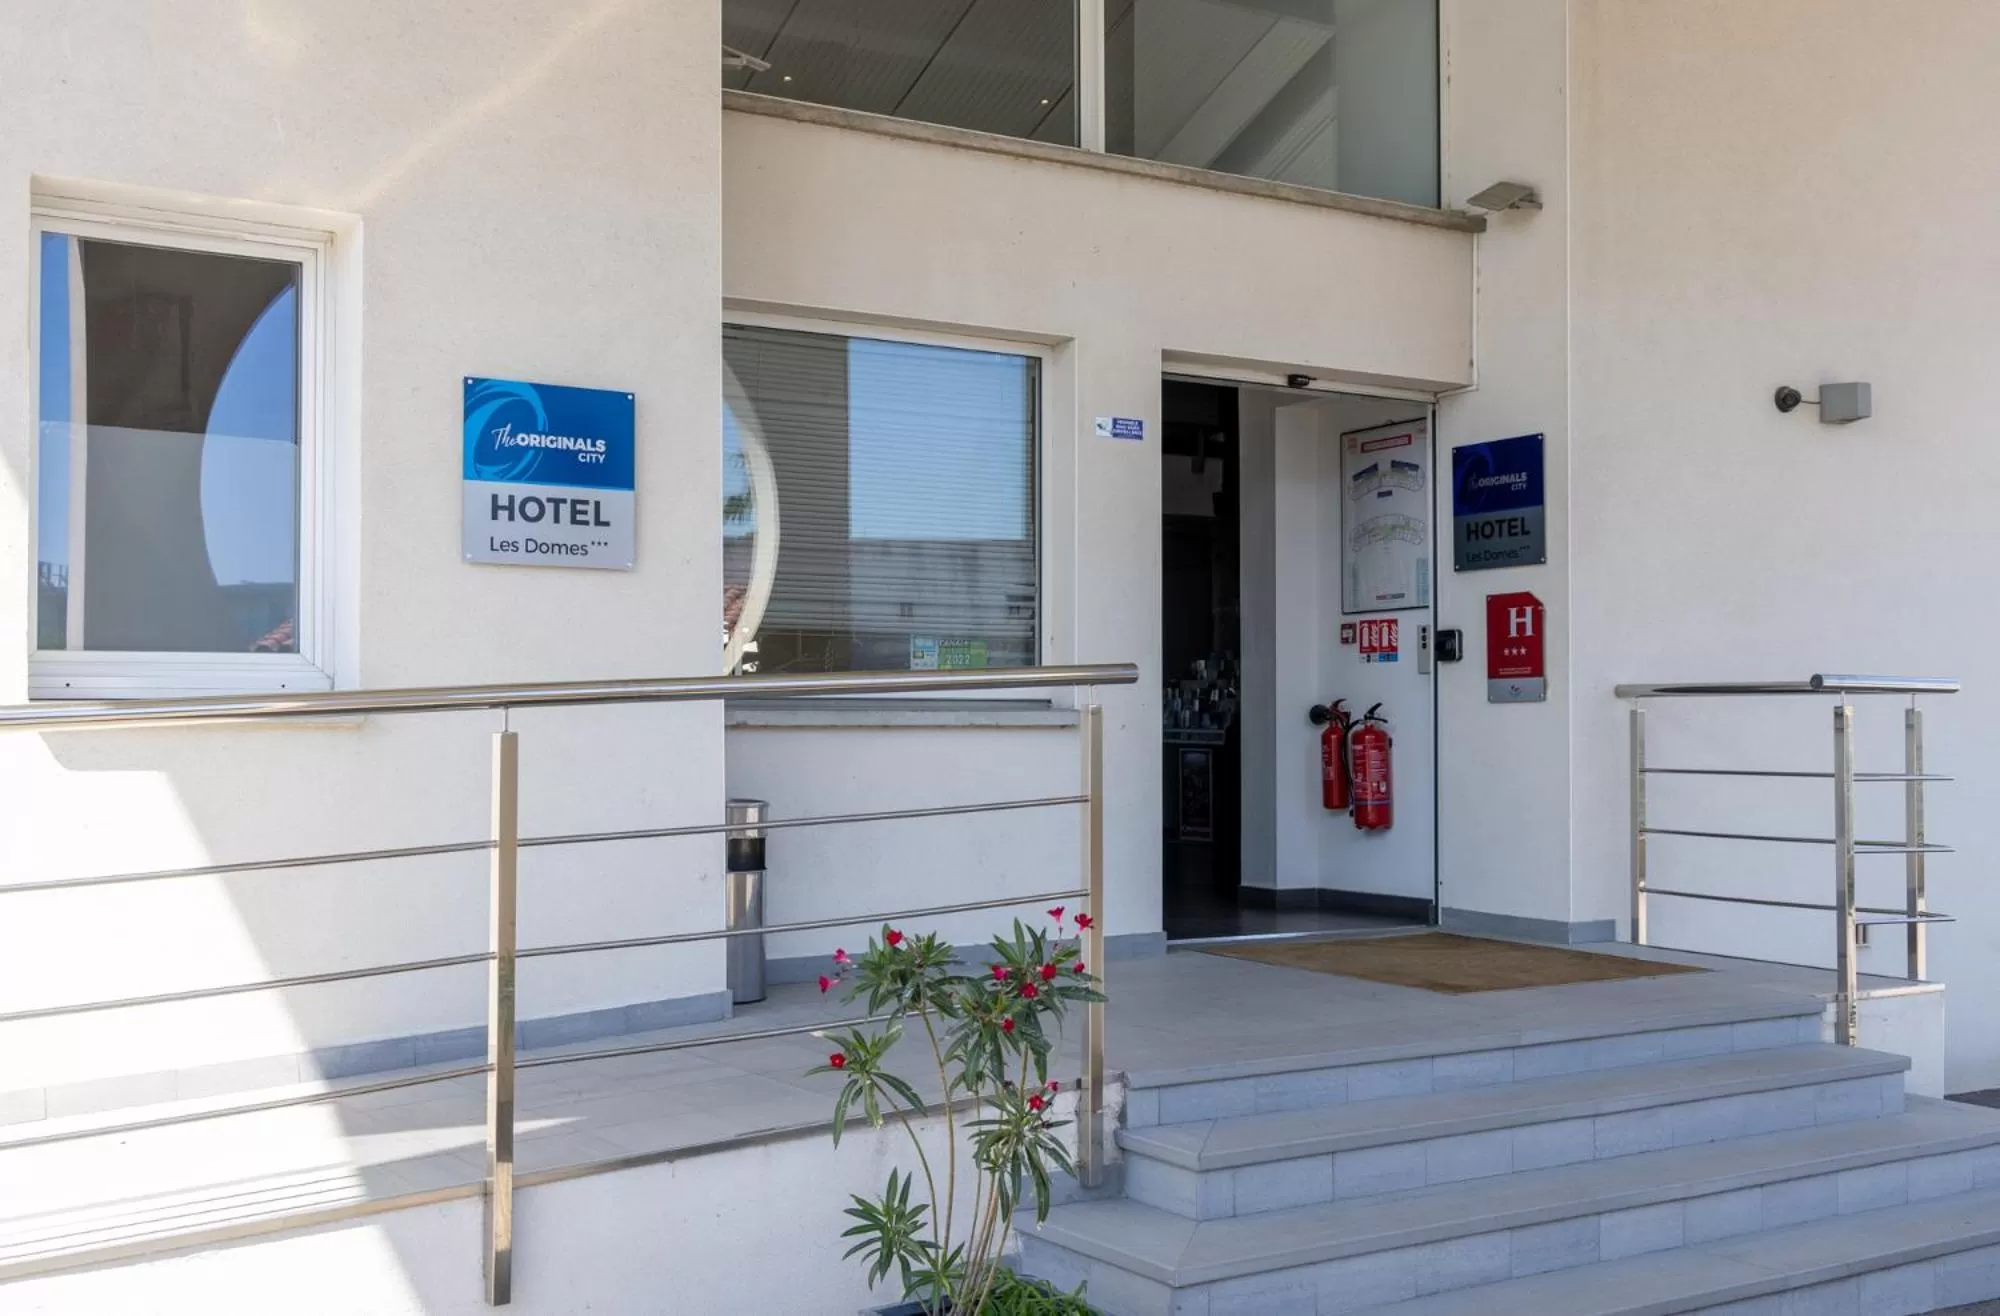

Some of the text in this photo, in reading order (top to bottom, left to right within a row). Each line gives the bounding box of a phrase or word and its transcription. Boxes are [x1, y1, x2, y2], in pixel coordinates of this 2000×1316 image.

[578, 453, 606, 464] CITY
[1511, 482, 1527, 491] CITY
[490, 493, 611, 528] HOTEL
[1466, 517, 1531, 542] HOTEL
[490, 536, 520, 553] Les
[1507, 605, 1536, 638] H
